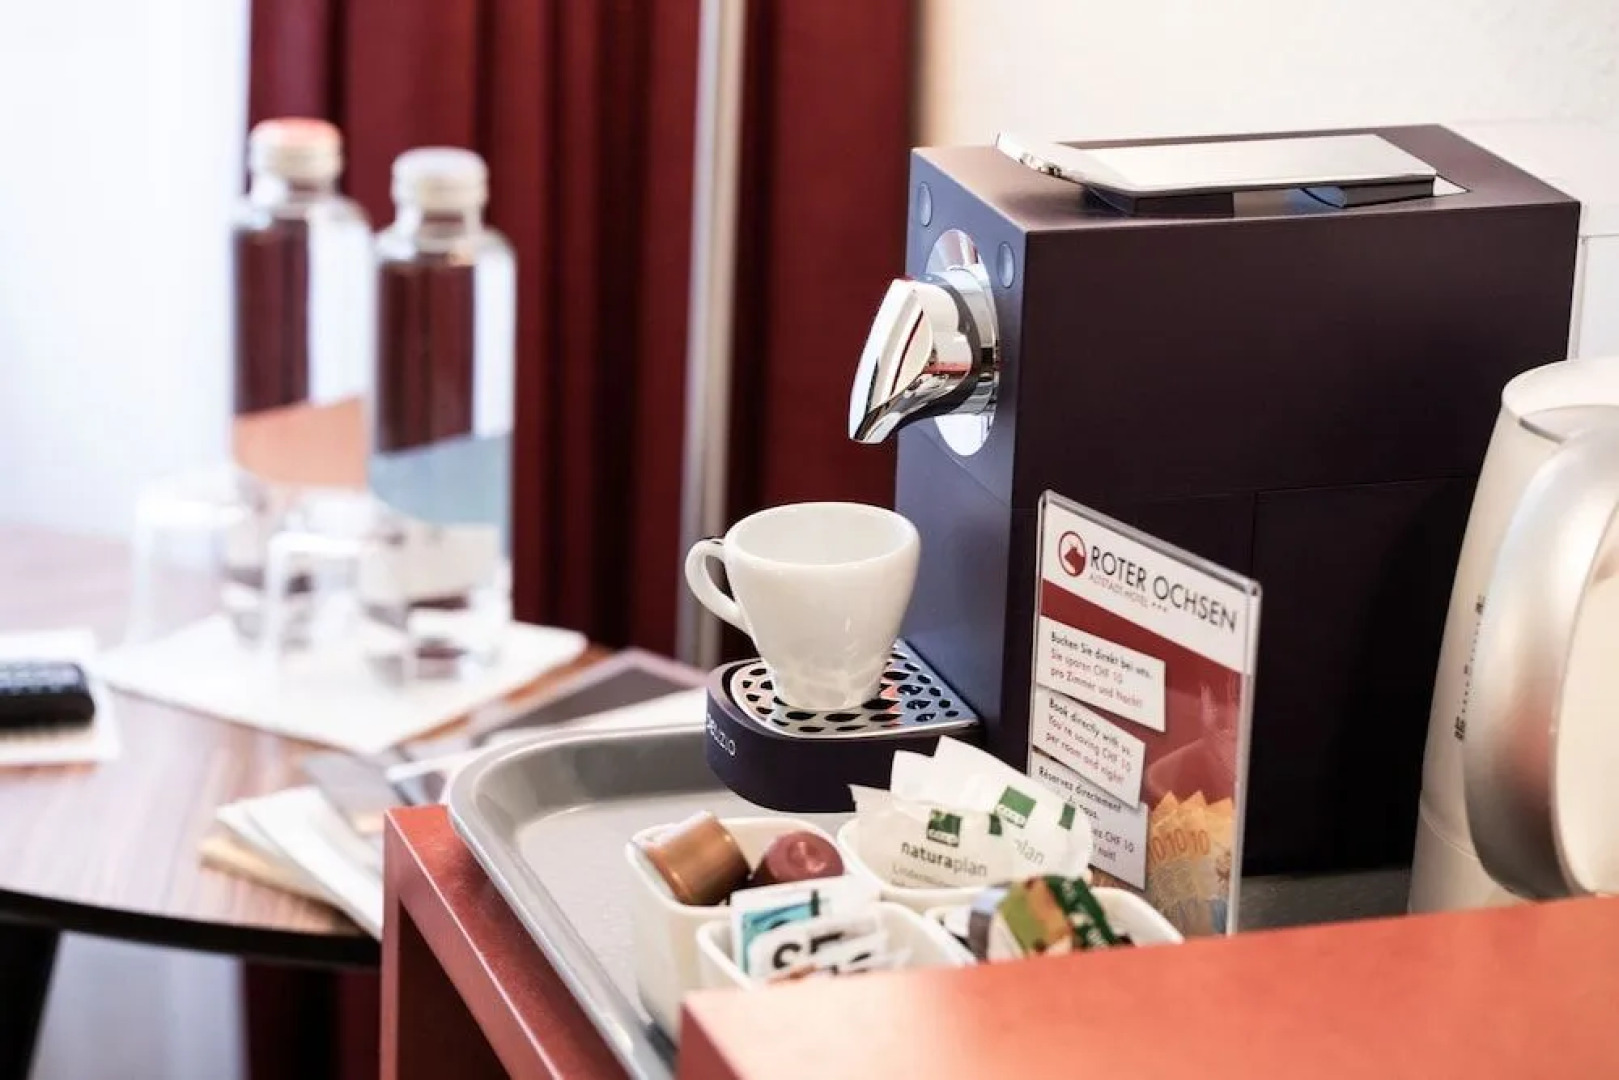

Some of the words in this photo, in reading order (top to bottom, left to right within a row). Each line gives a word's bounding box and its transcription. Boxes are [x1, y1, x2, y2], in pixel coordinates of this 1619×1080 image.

[1090, 545, 1147, 594] ROTER
[1153, 575, 1238, 634] OCHSEN
[1051, 630, 1078, 650] Buchen
[1081, 642, 1093, 657] Sie
[1095, 647, 1118, 665] direkt
[1049, 697, 1068, 717] Book
[901, 840, 988, 877] naturaplan
